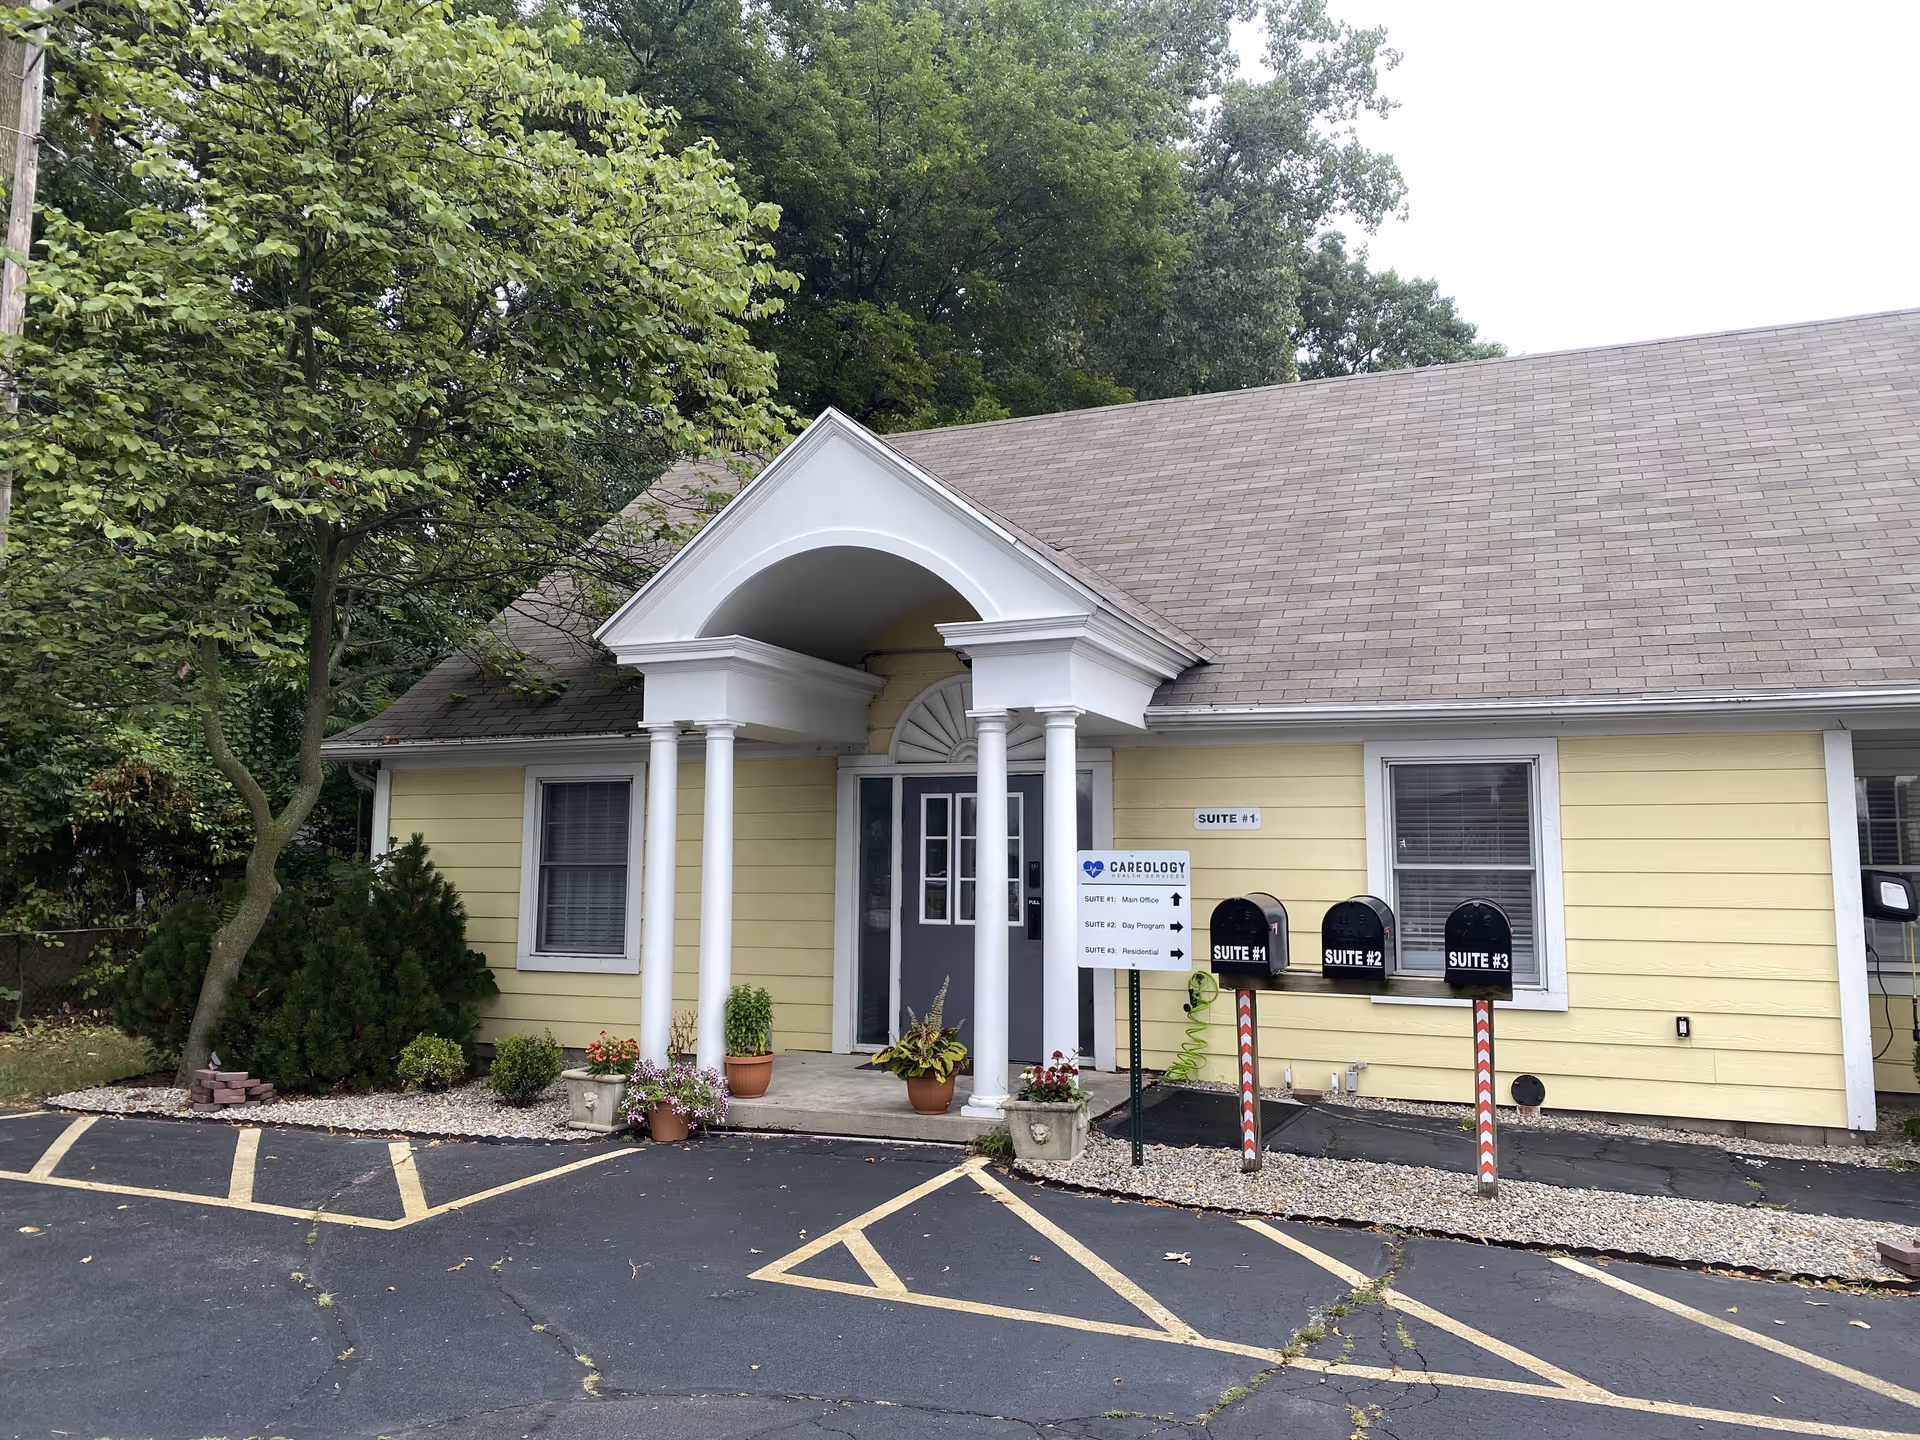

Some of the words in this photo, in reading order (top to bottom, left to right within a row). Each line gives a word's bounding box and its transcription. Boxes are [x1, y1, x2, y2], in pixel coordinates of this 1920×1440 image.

[1198, 814, 1237, 823] SUITE
[1242, 814, 1255, 823] #1
[1110, 861, 1185, 873] CAREOLOGY
[1139, 896, 1160, 904] Office
[1122, 922, 1135, 930] Day
[1136, 922, 1166, 930] Program
[1122, 947, 1160, 956] Residential
[1213, 945, 1250, 960] SUITE
[1252, 946, 1266, 961] #1
[1325, 949, 1363, 965] SUITE
[1366, 950, 1382, 966] #2
[1448, 951, 1489, 968] SUITE
[1492, 952, 1509, 969] #3
